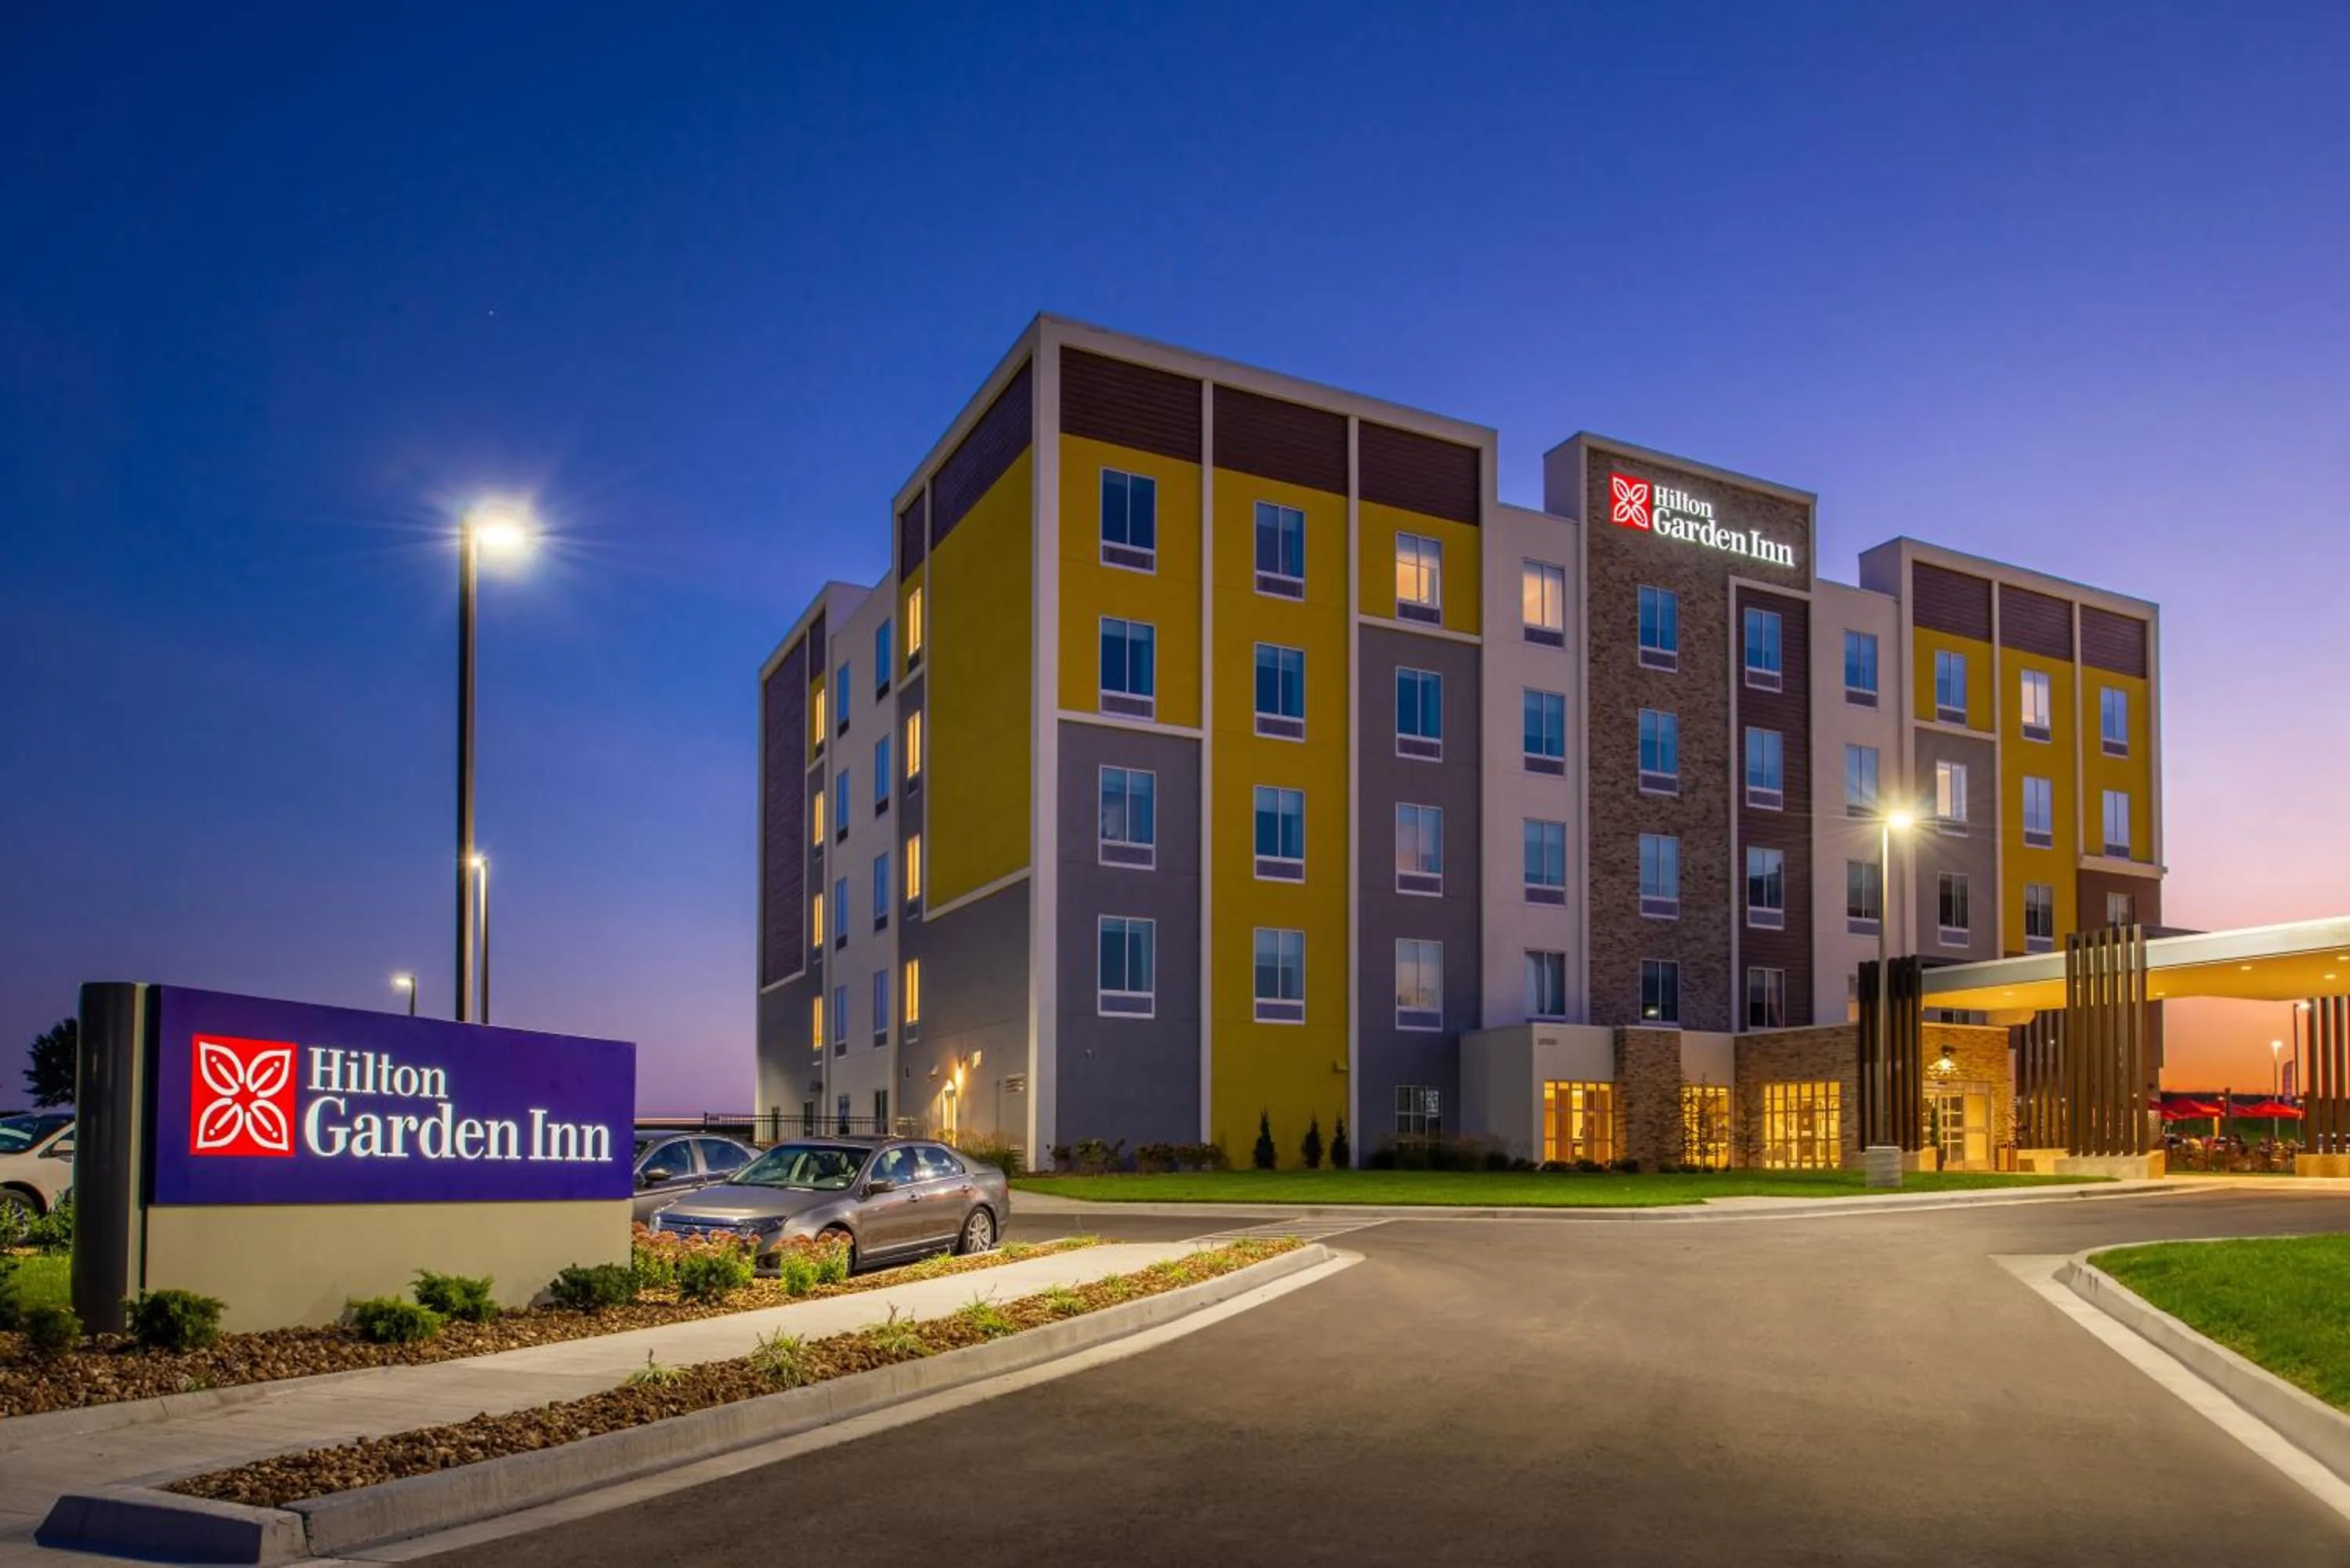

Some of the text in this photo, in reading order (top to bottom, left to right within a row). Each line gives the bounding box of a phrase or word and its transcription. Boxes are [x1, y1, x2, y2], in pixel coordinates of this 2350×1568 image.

[1654, 486, 1712, 518] Hilton
[1653, 508, 1795, 565] Garden Inn
[308, 1047, 448, 1097] Hilton
[305, 1097, 613, 1161] Garden Inn
